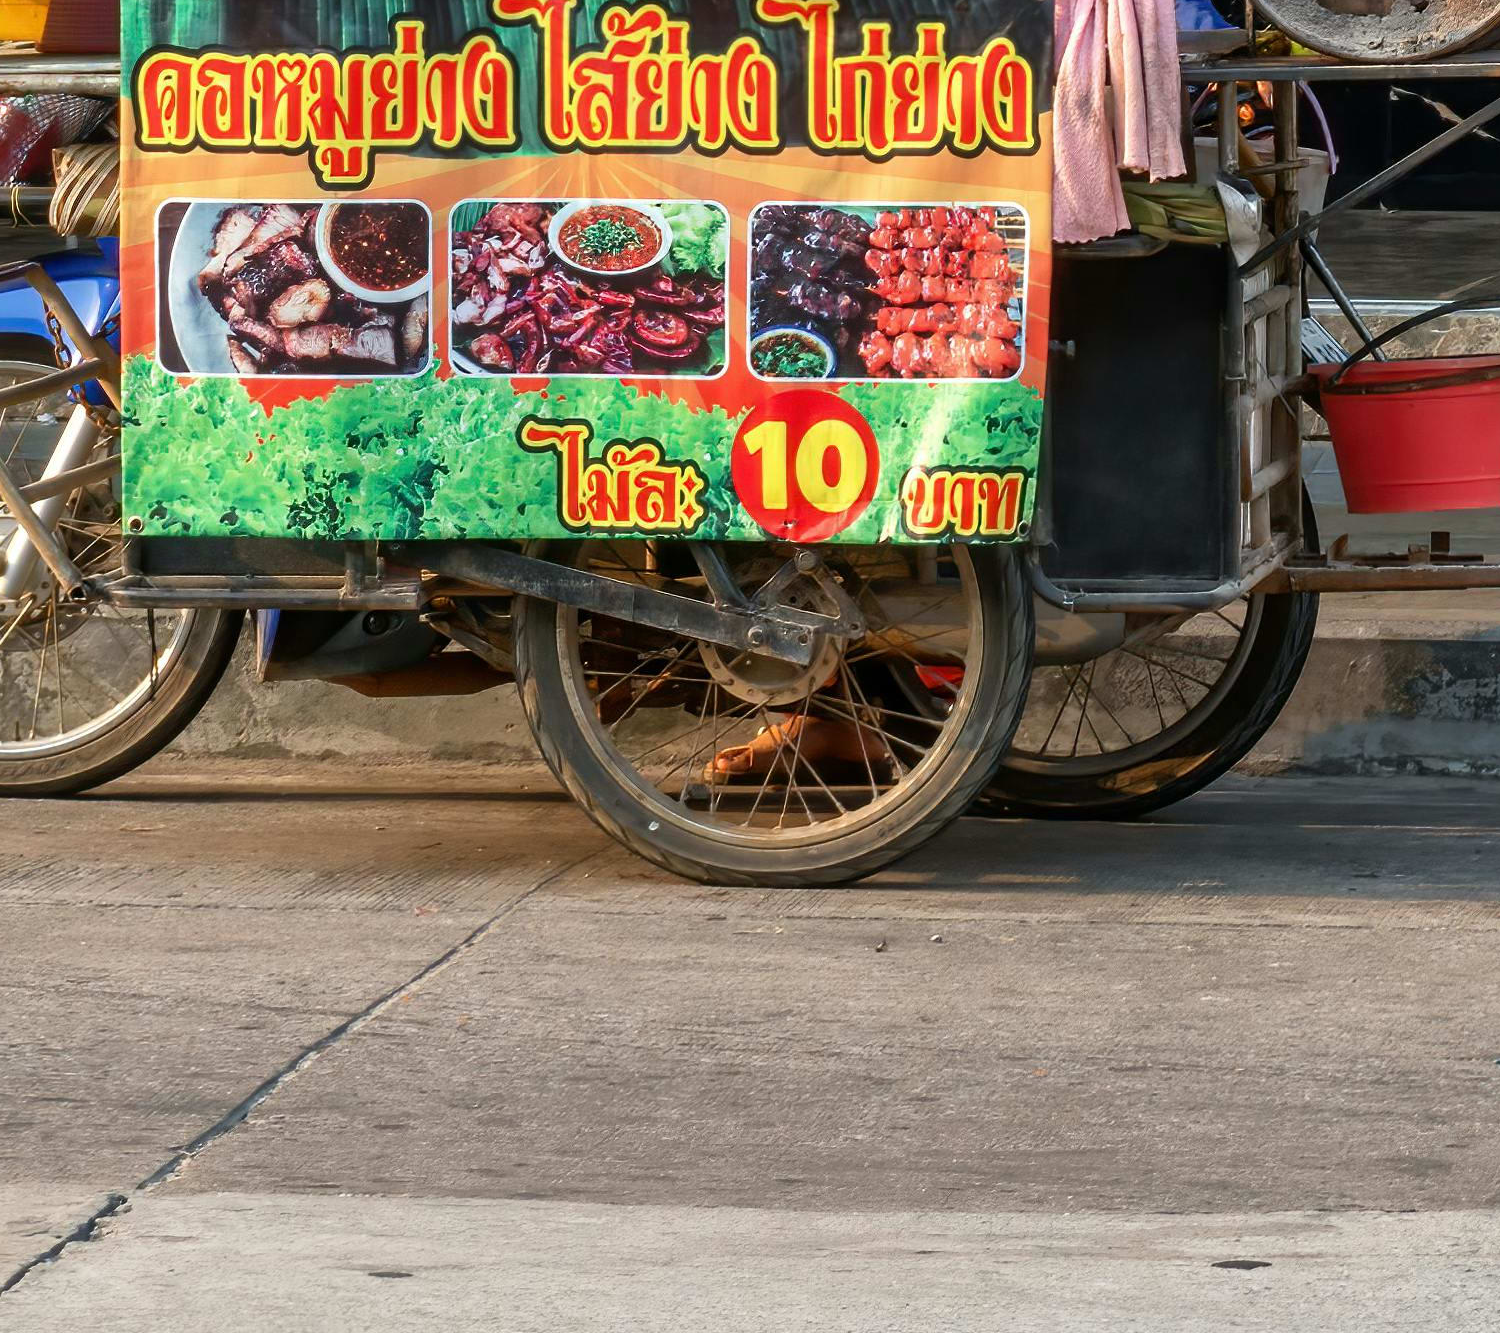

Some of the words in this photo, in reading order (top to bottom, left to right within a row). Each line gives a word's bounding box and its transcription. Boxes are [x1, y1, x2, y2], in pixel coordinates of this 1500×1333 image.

[136, 18, 518, 184] คอหมูย่าง
[524, 422, 704, 528] ไม้ละ
[742, 419, 868, 511] 10
[899, 466, 1027, 537] บาท
